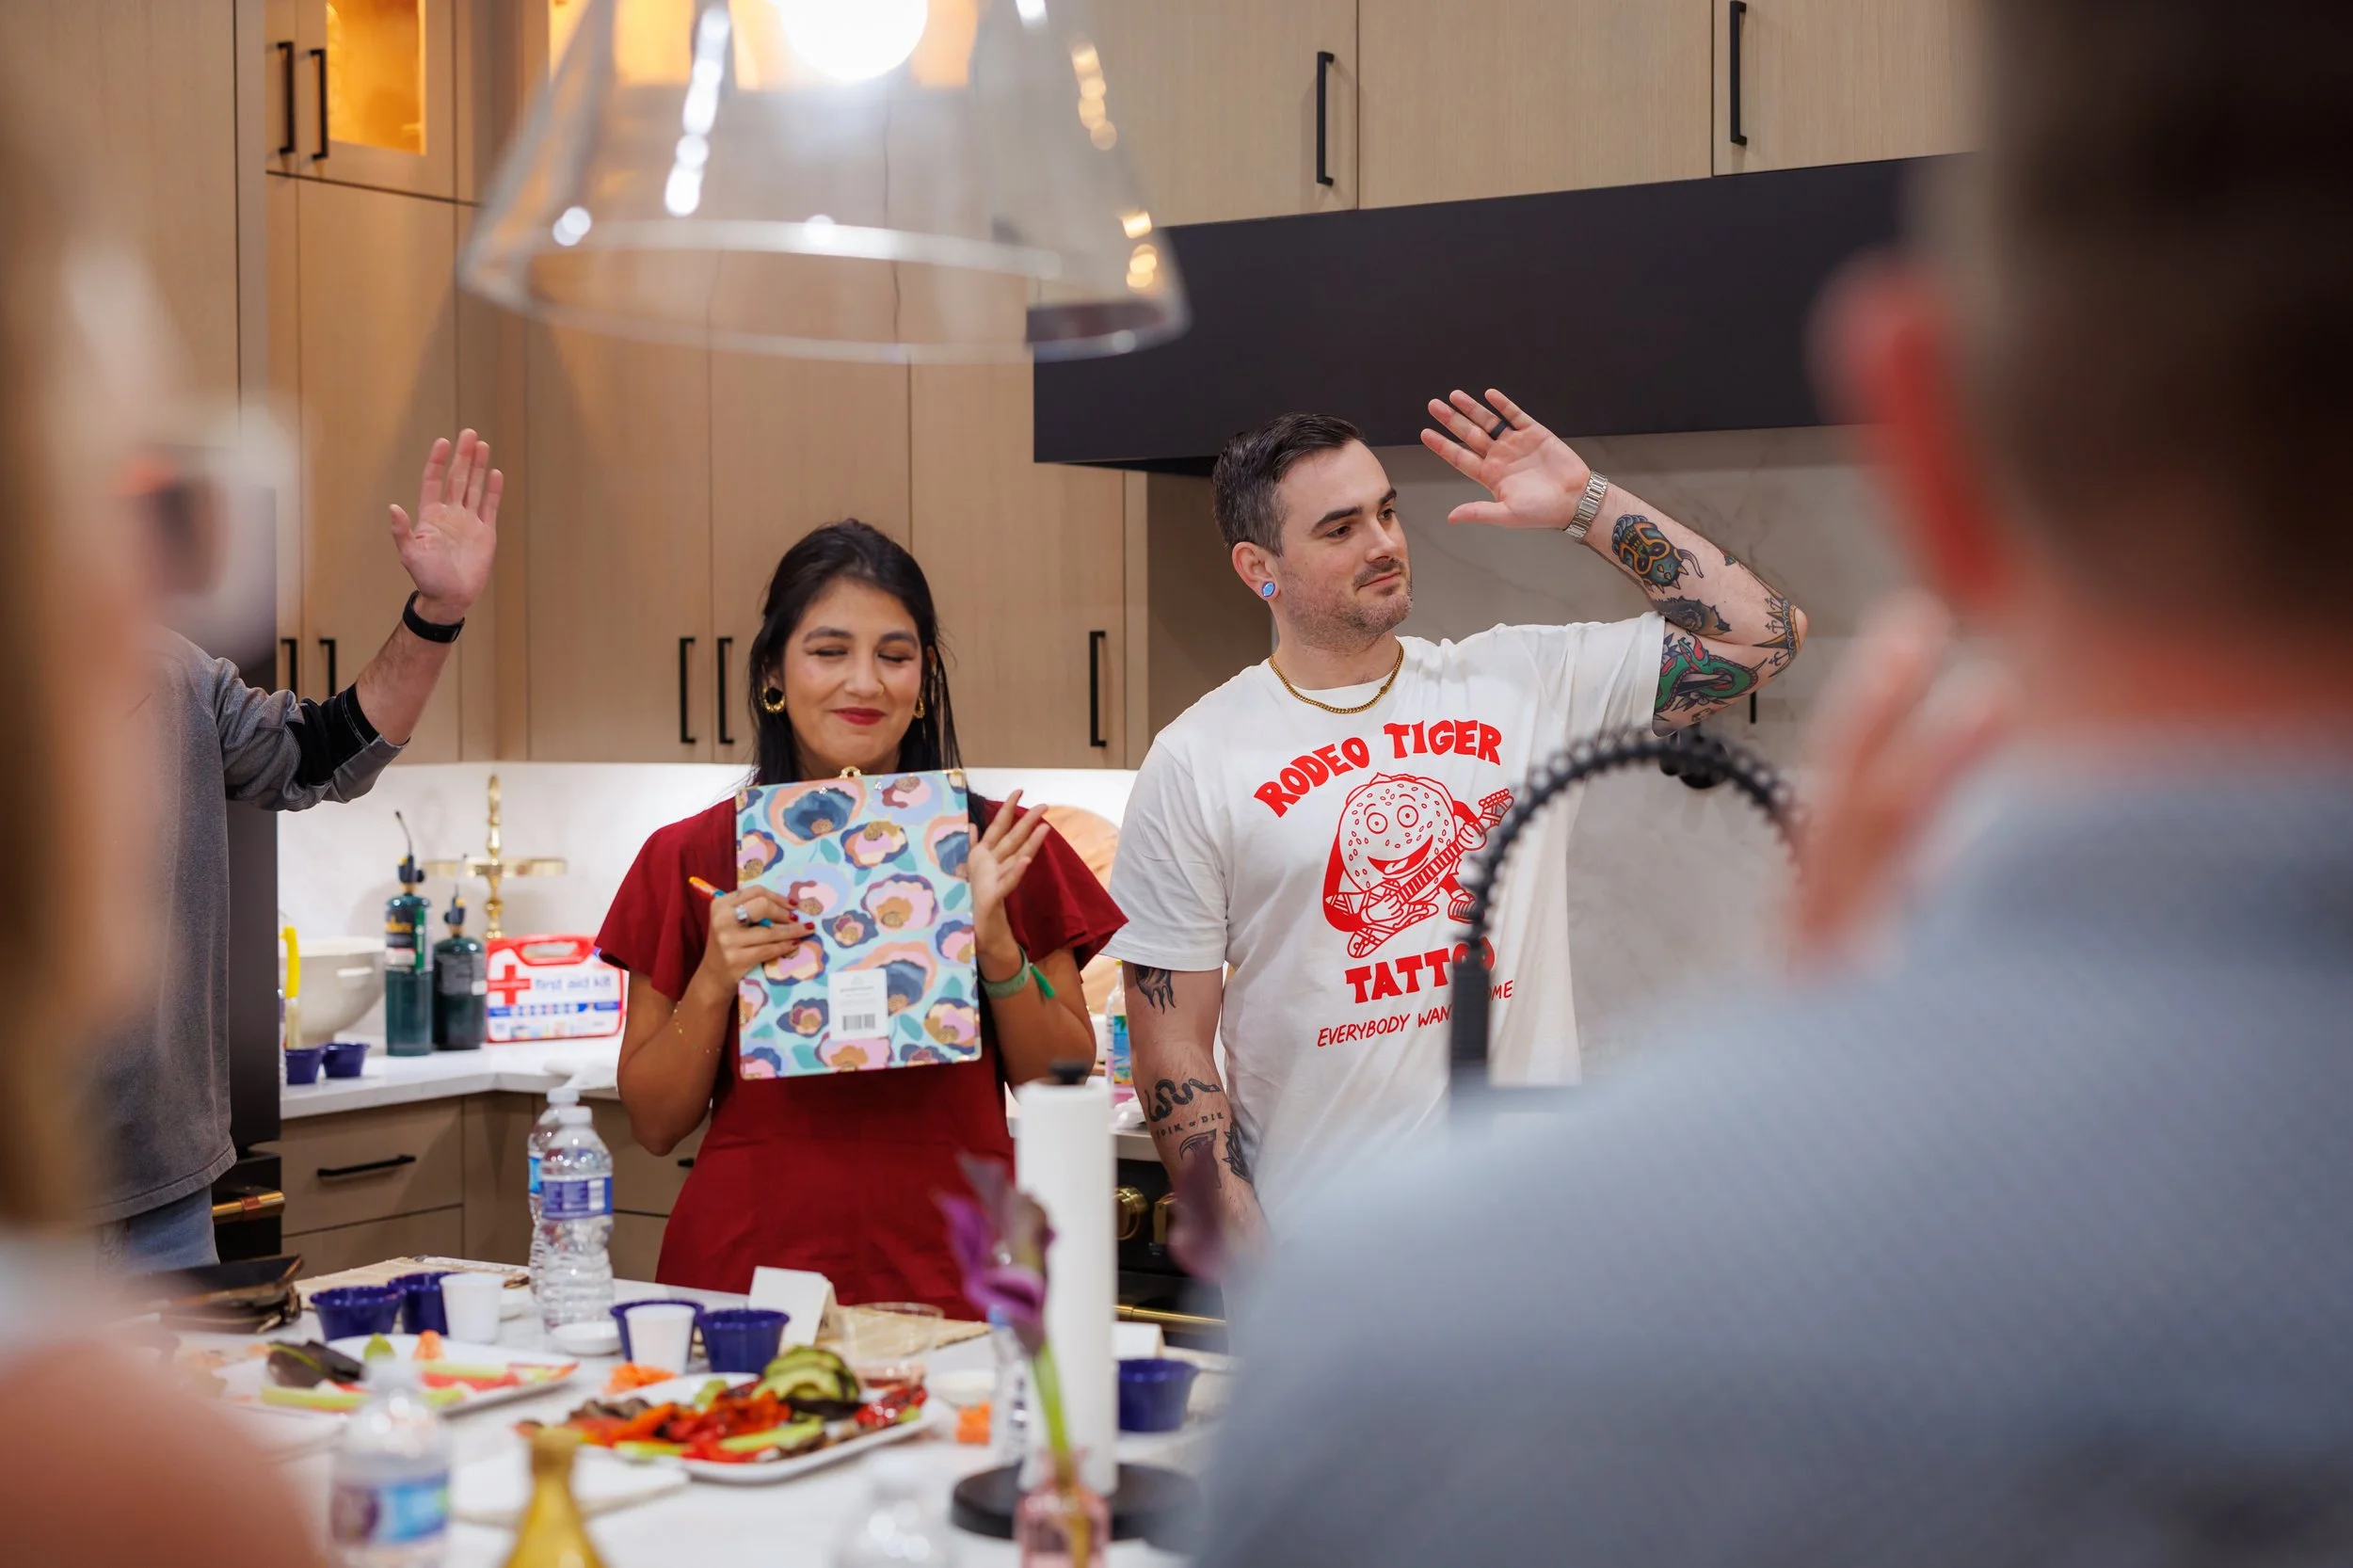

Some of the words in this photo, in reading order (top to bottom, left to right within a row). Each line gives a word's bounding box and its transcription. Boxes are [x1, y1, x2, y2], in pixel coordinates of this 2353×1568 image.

[1253, 736, 1370, 819] RODEO
[1383, 719, 1503, 766] TIGER
[1317, 1014, 1411, 1048] EVERYBODY
[1417, 1003, 1452, 1028] WAN
[1488, 980, 1513, 1001] ME
[1201, 1112, 1224, 1124] DIE
